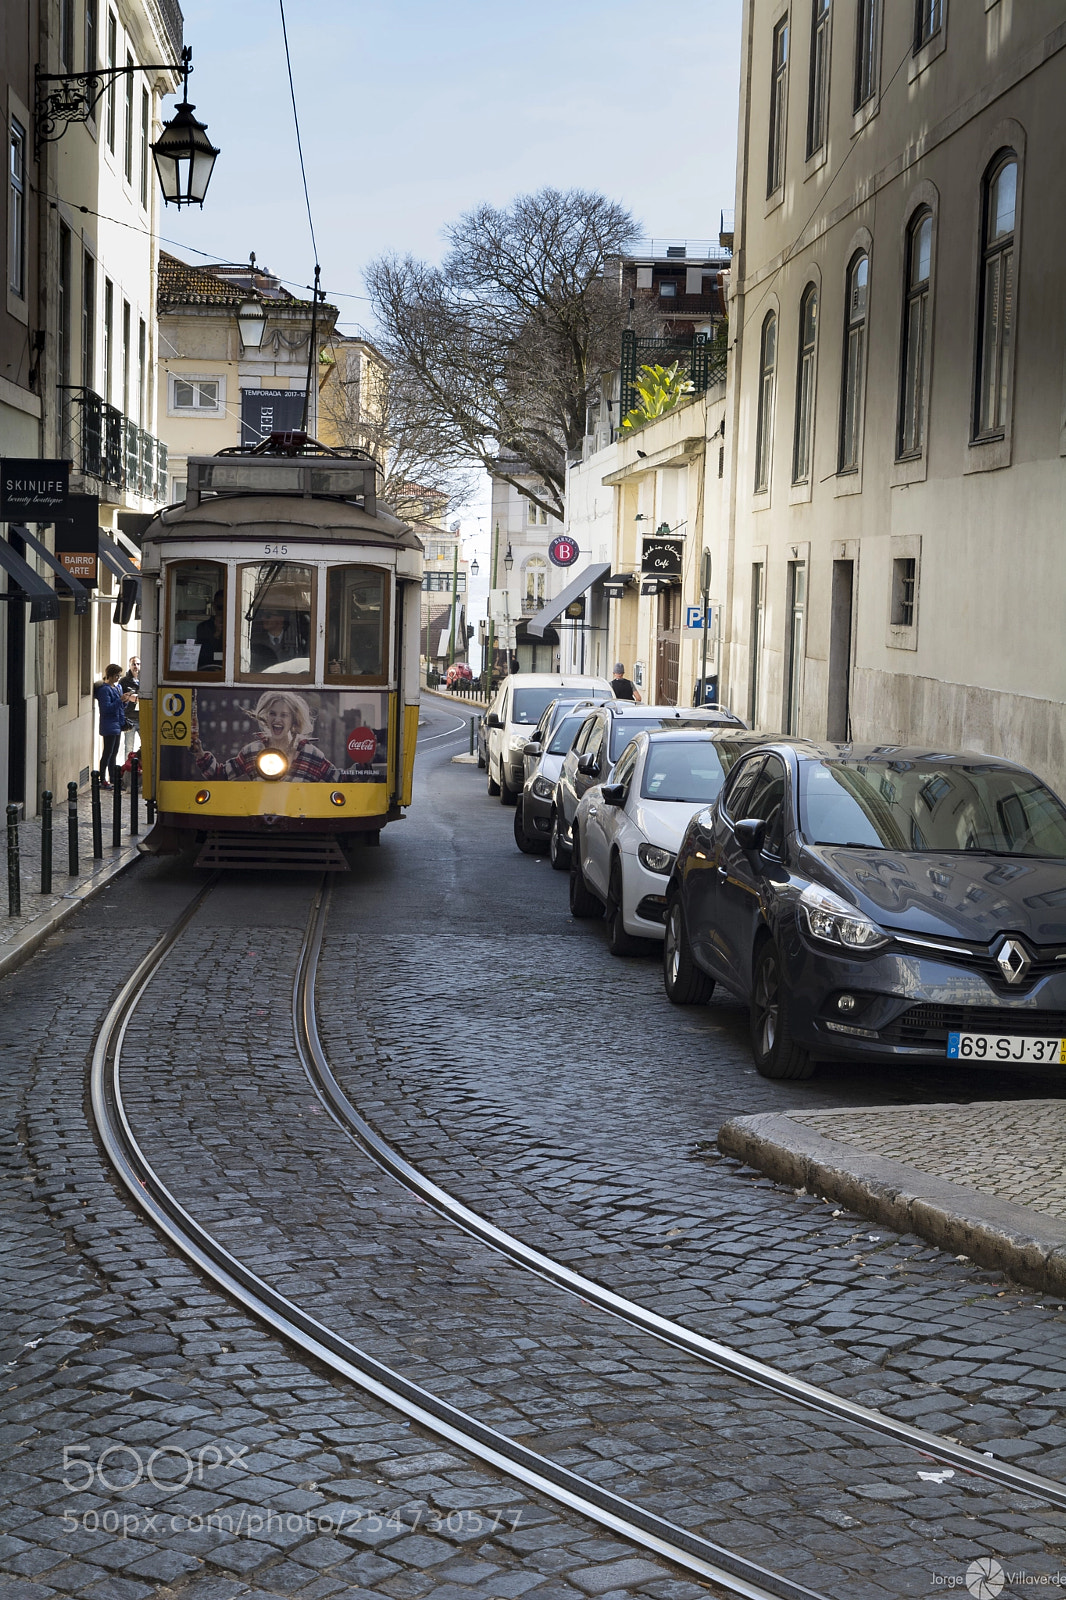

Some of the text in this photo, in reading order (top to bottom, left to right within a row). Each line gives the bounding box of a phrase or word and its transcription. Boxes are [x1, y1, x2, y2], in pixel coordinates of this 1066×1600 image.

[244, 389, 282, 397] TEMPORADA
[6, 479, 63, 494] SKINLIFE
[264, 544, 288, 555] 545
[559, 544, 571, 559] B
[64, 556, 94, 565] BAIRRO
[69, 566, 90, 575] ARTE
[688, 609, 702, 627] P
[705, 684, 713, 696] P
